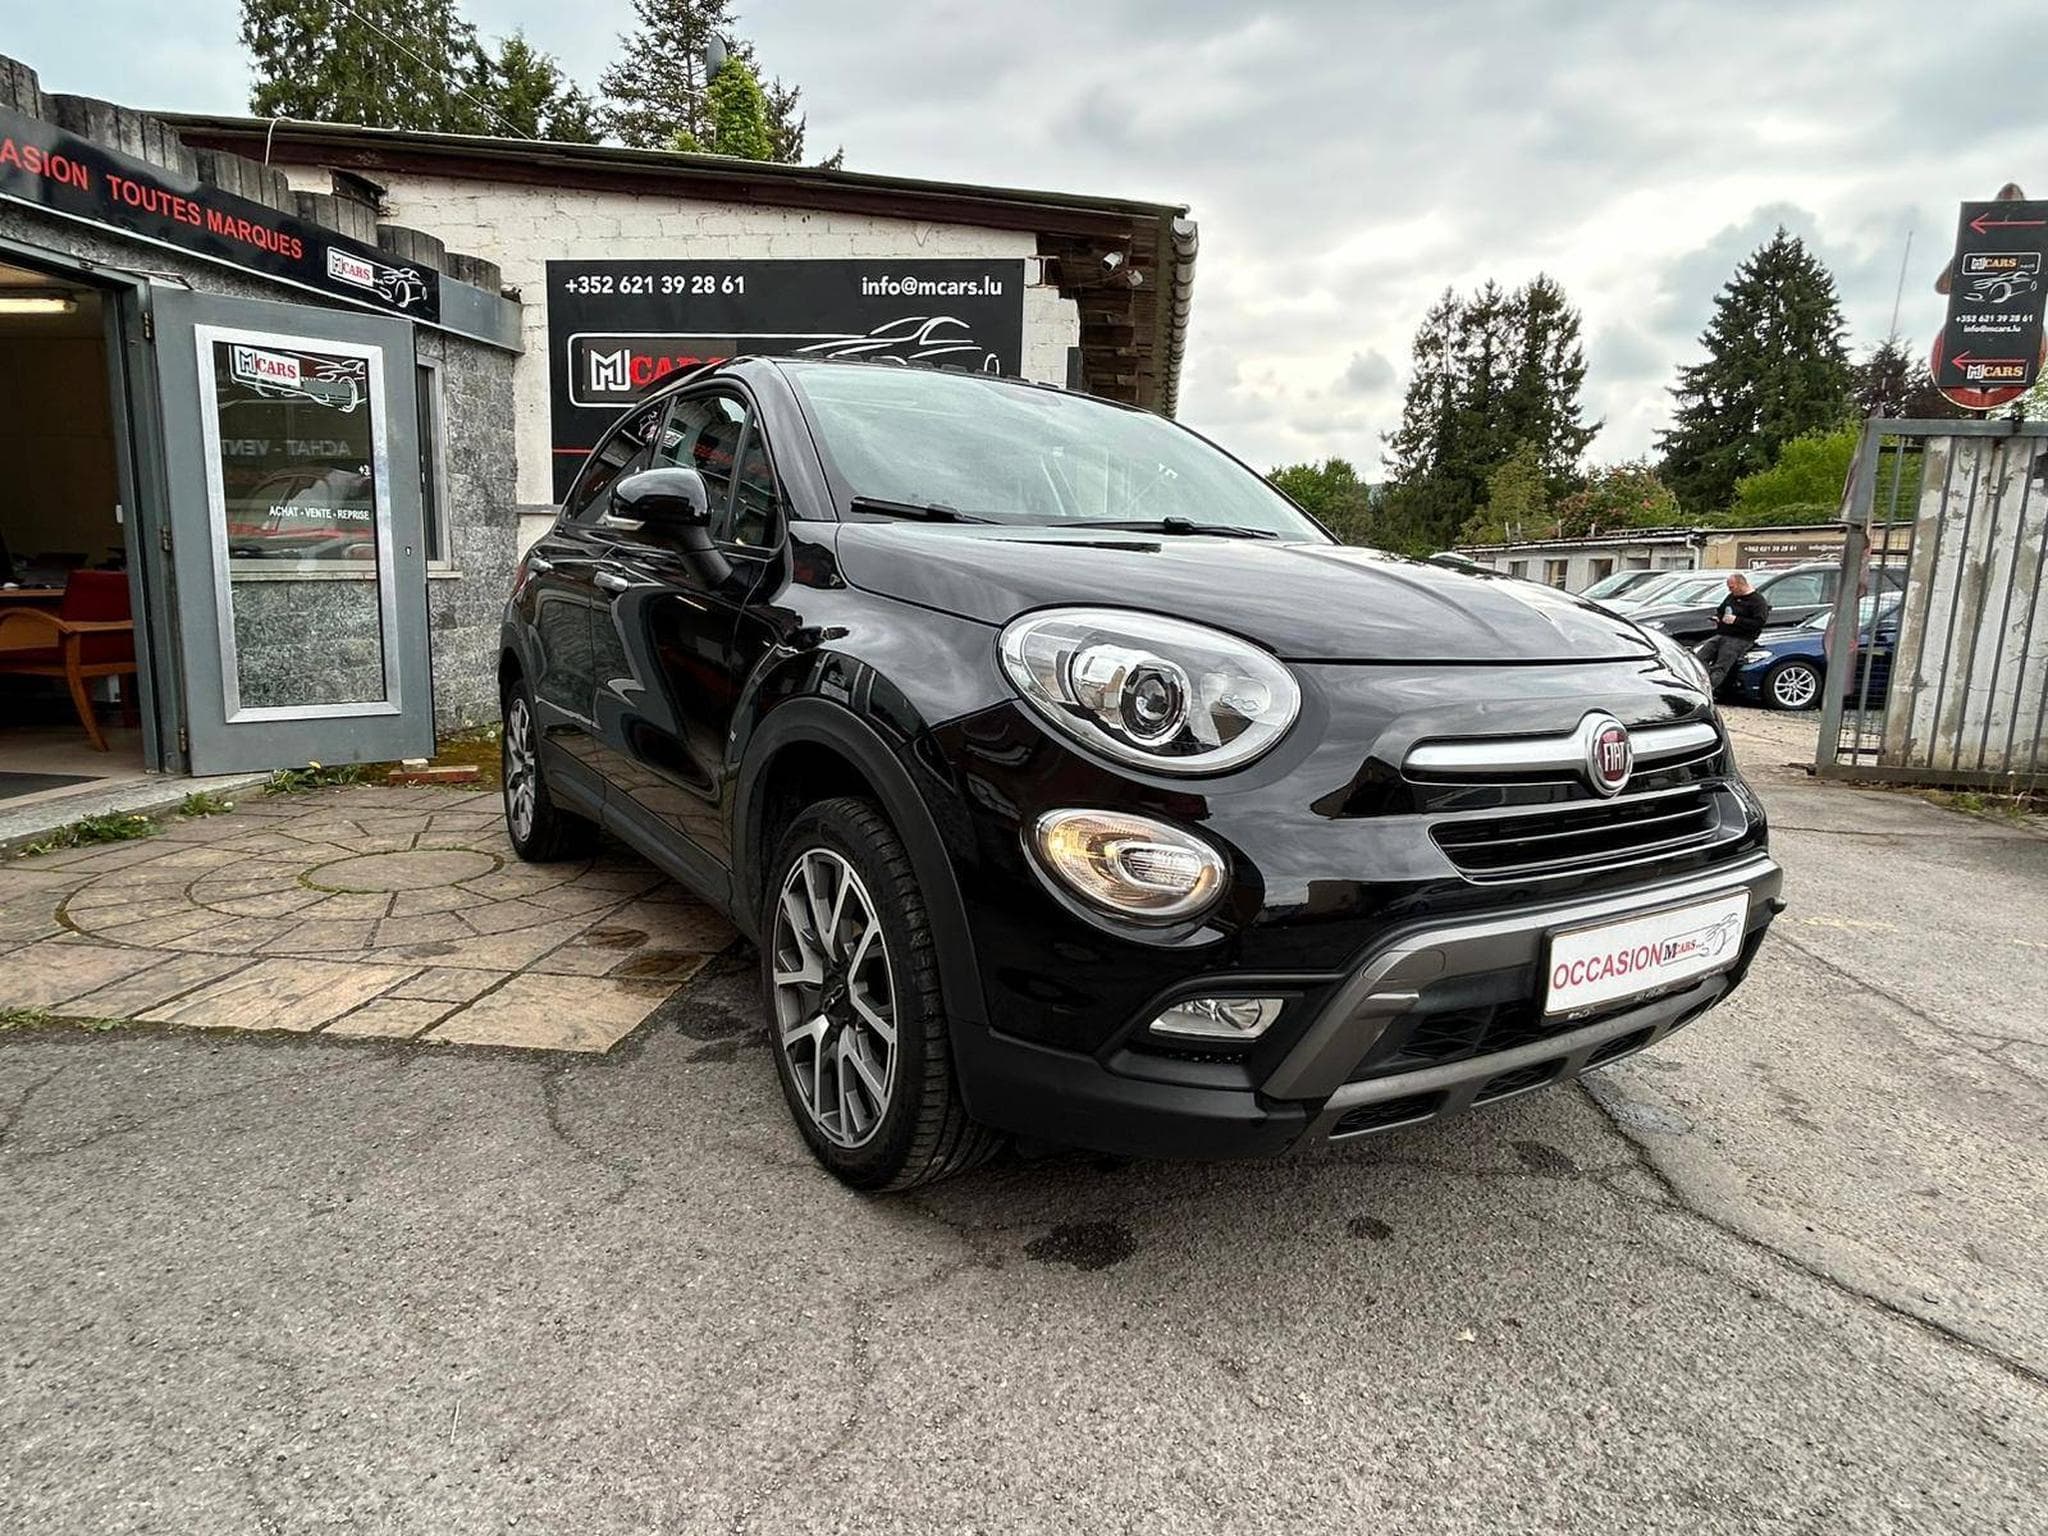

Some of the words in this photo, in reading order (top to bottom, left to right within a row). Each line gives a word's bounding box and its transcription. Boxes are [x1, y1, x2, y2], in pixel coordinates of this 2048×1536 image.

[0, 137, 88, 190] ASION
[106, 174, 201, 226] TOUTES
[207, 208, 302, 259] MARQUES
[565, 276, 613, 294] +352
[619, 276, 653, 294] 621
[661, 276, 685, 294] 39
[691, 276, 715, 294] 28
[721, 276, 744, 294] 61
[862, 275, 1002, 296] info@mcars.lu
[269, 506, 298, 517] ACHAT
[305, 507, 332, 519] VENTE
[337, 509, 370, 520] REPRISE
[1603, 741, 1625, 772] FIAT
[1553, 943, 1661, 989] OCCASION
